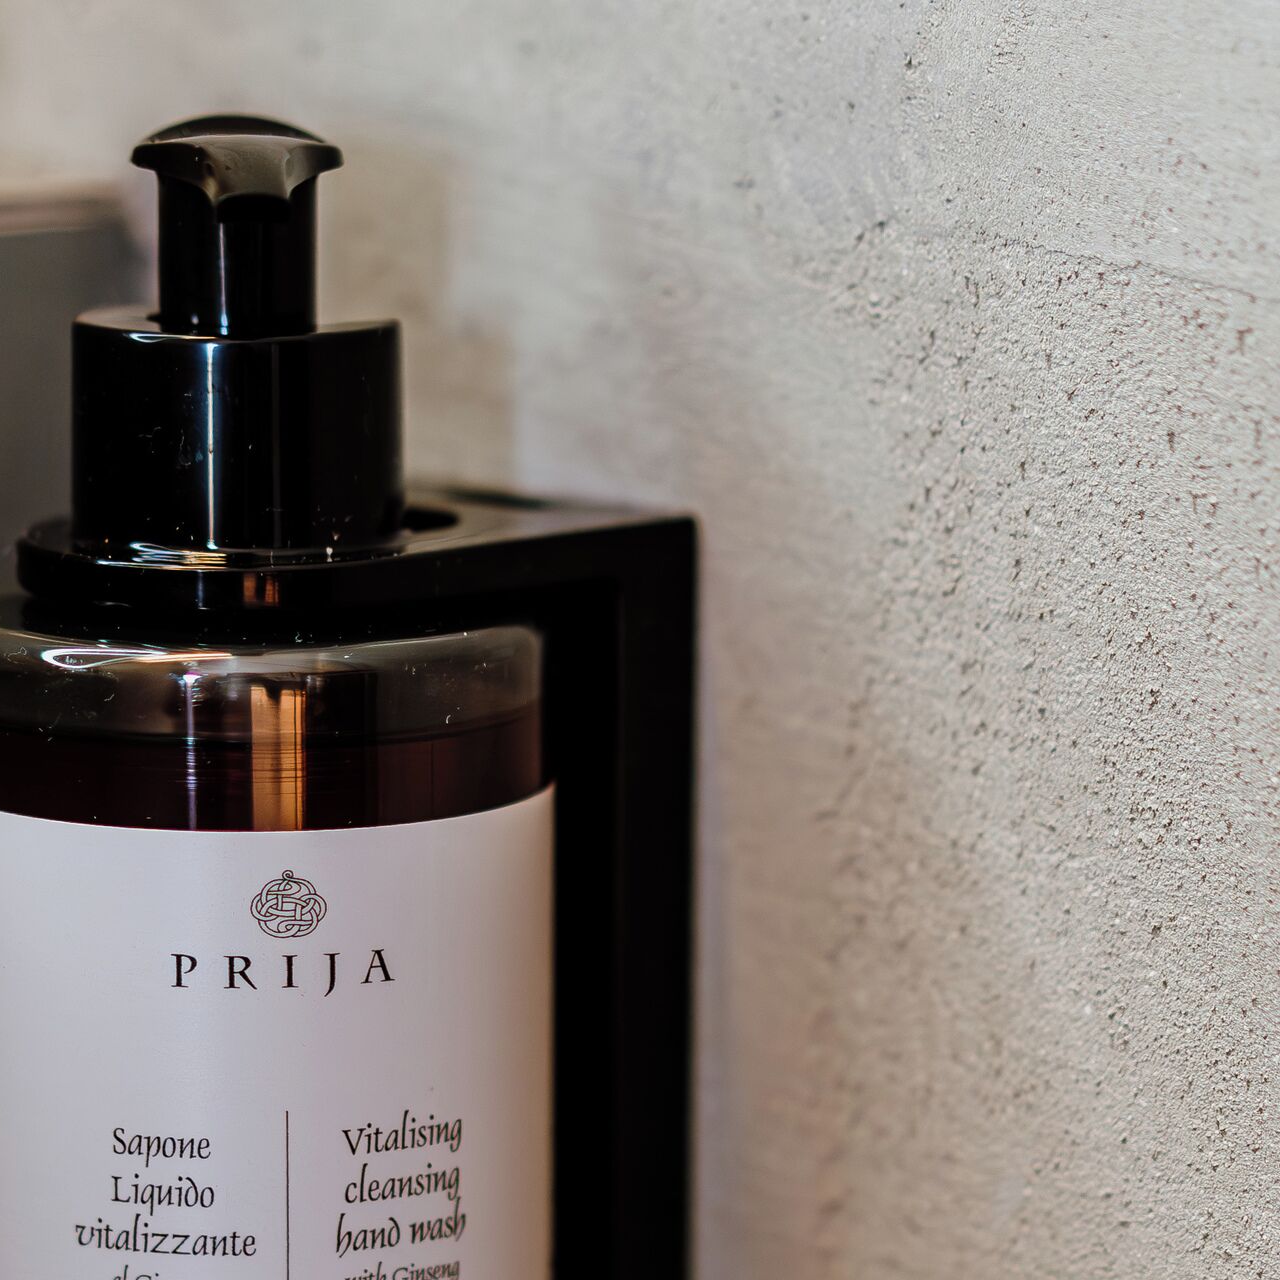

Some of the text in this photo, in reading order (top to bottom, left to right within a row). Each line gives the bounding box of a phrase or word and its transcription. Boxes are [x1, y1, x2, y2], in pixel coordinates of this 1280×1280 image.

[170, 948, 396, 998] PRIJA
[112, 1127, 212, 1169] Sapone
[340, 1108, 463, 1157] Vitalising
[110, 1172, 215, 1217] Liquido
[344, 1164, 461, 1204] cleansing
[74, 1212, 257, 1257] vitalizzante
[335, 1198, 467, 1259] hand wash
